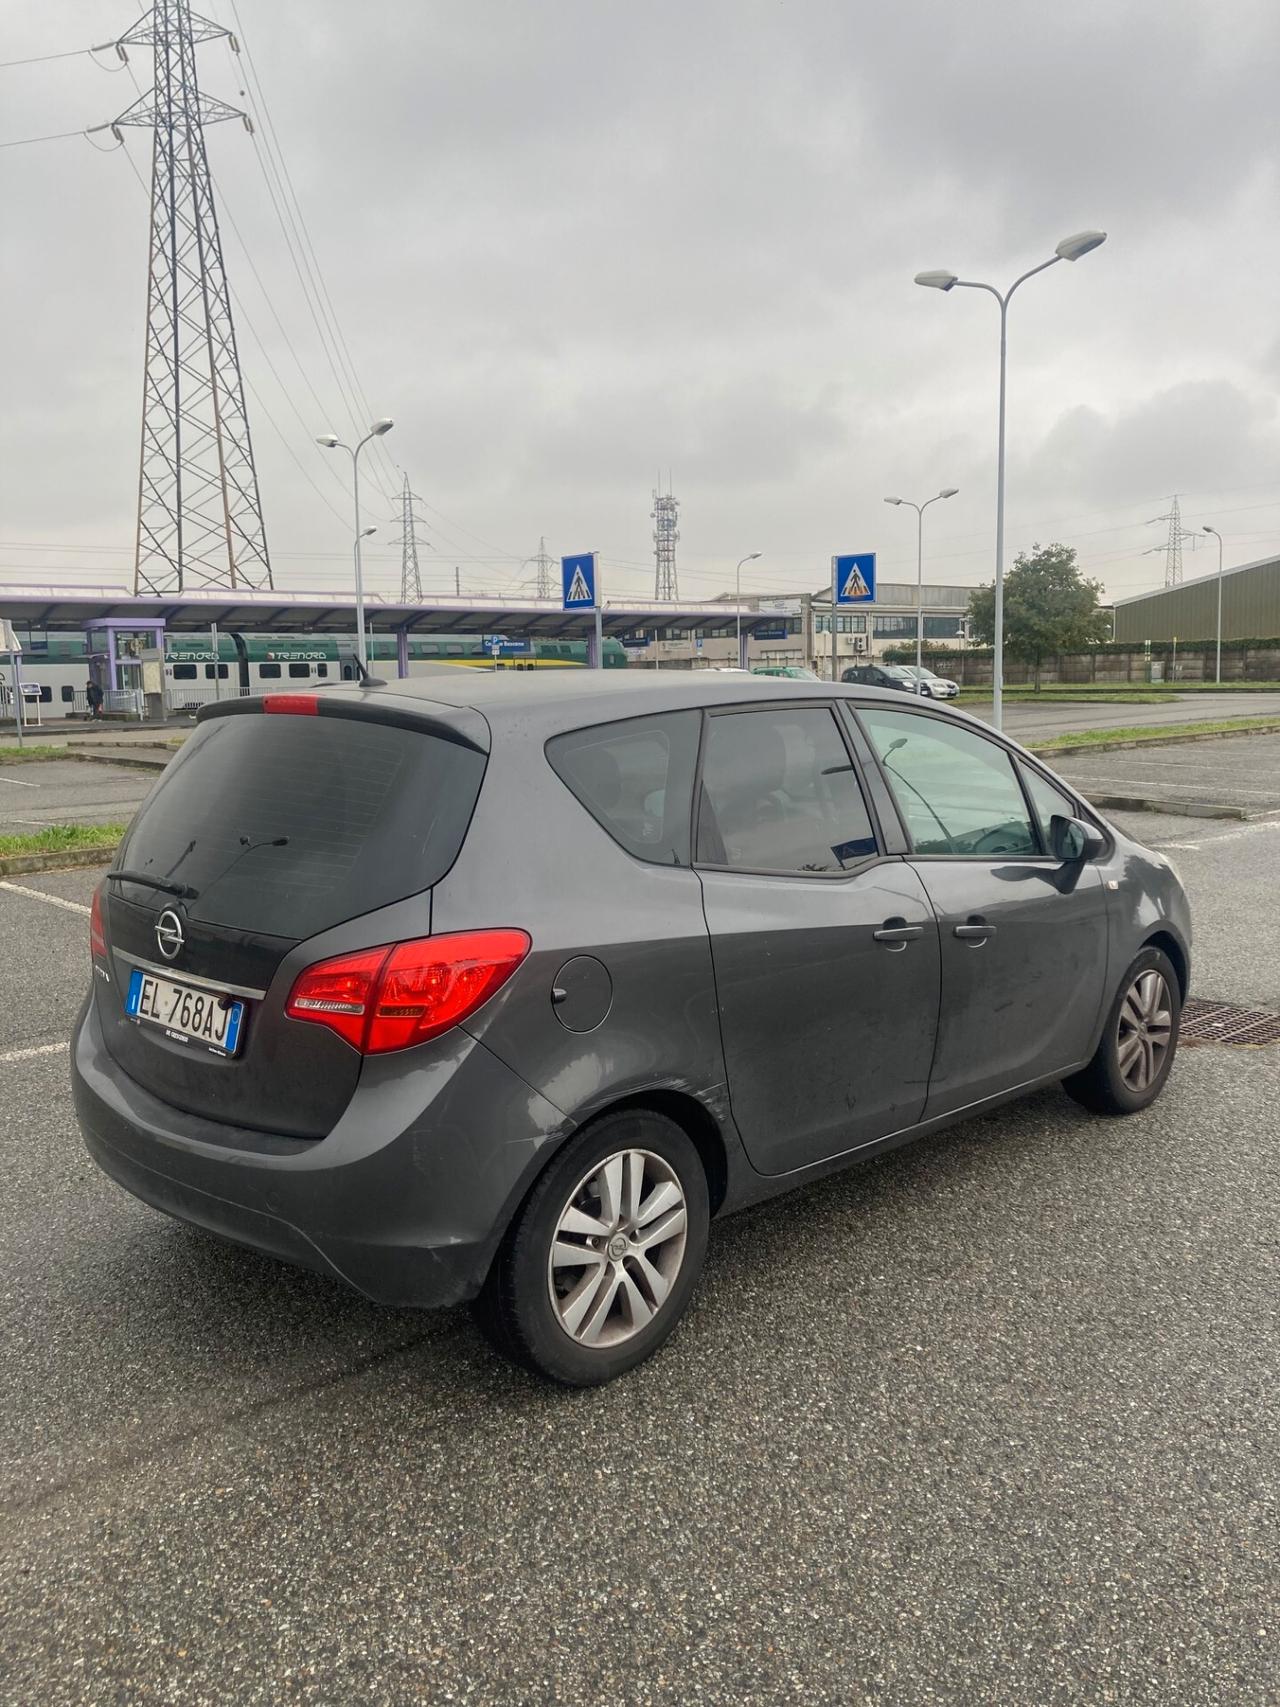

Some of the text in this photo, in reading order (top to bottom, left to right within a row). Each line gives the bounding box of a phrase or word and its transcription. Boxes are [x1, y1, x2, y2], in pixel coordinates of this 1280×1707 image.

[276, 652, 327, 660] TRENORD
[140, 980, 228, 1040] EL 768AJ
